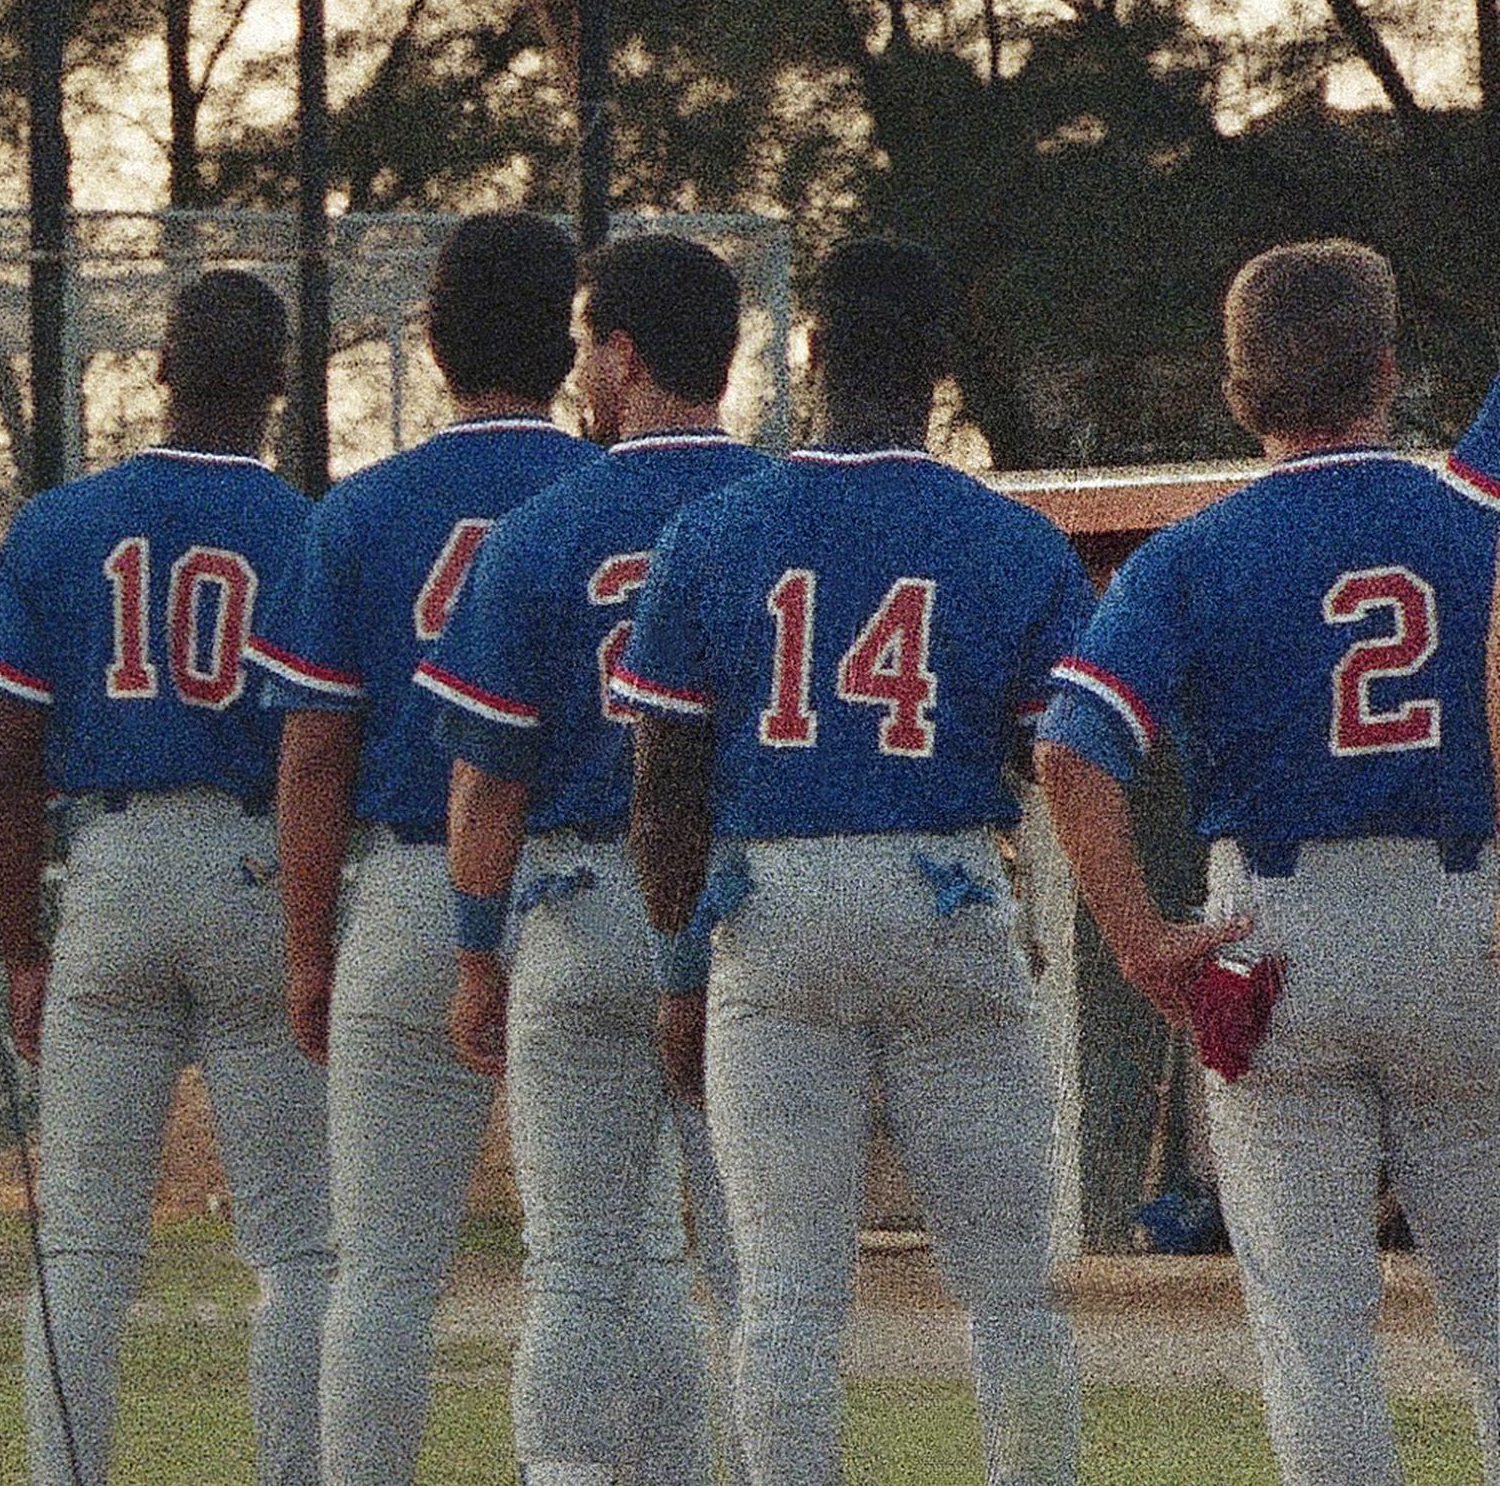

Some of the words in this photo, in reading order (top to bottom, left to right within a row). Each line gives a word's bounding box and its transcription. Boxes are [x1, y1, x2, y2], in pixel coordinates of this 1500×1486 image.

[104, 536, 258, 710] 10
[758, 568, 939, 757] 14
[1323, 565, 1441, 757] 2
